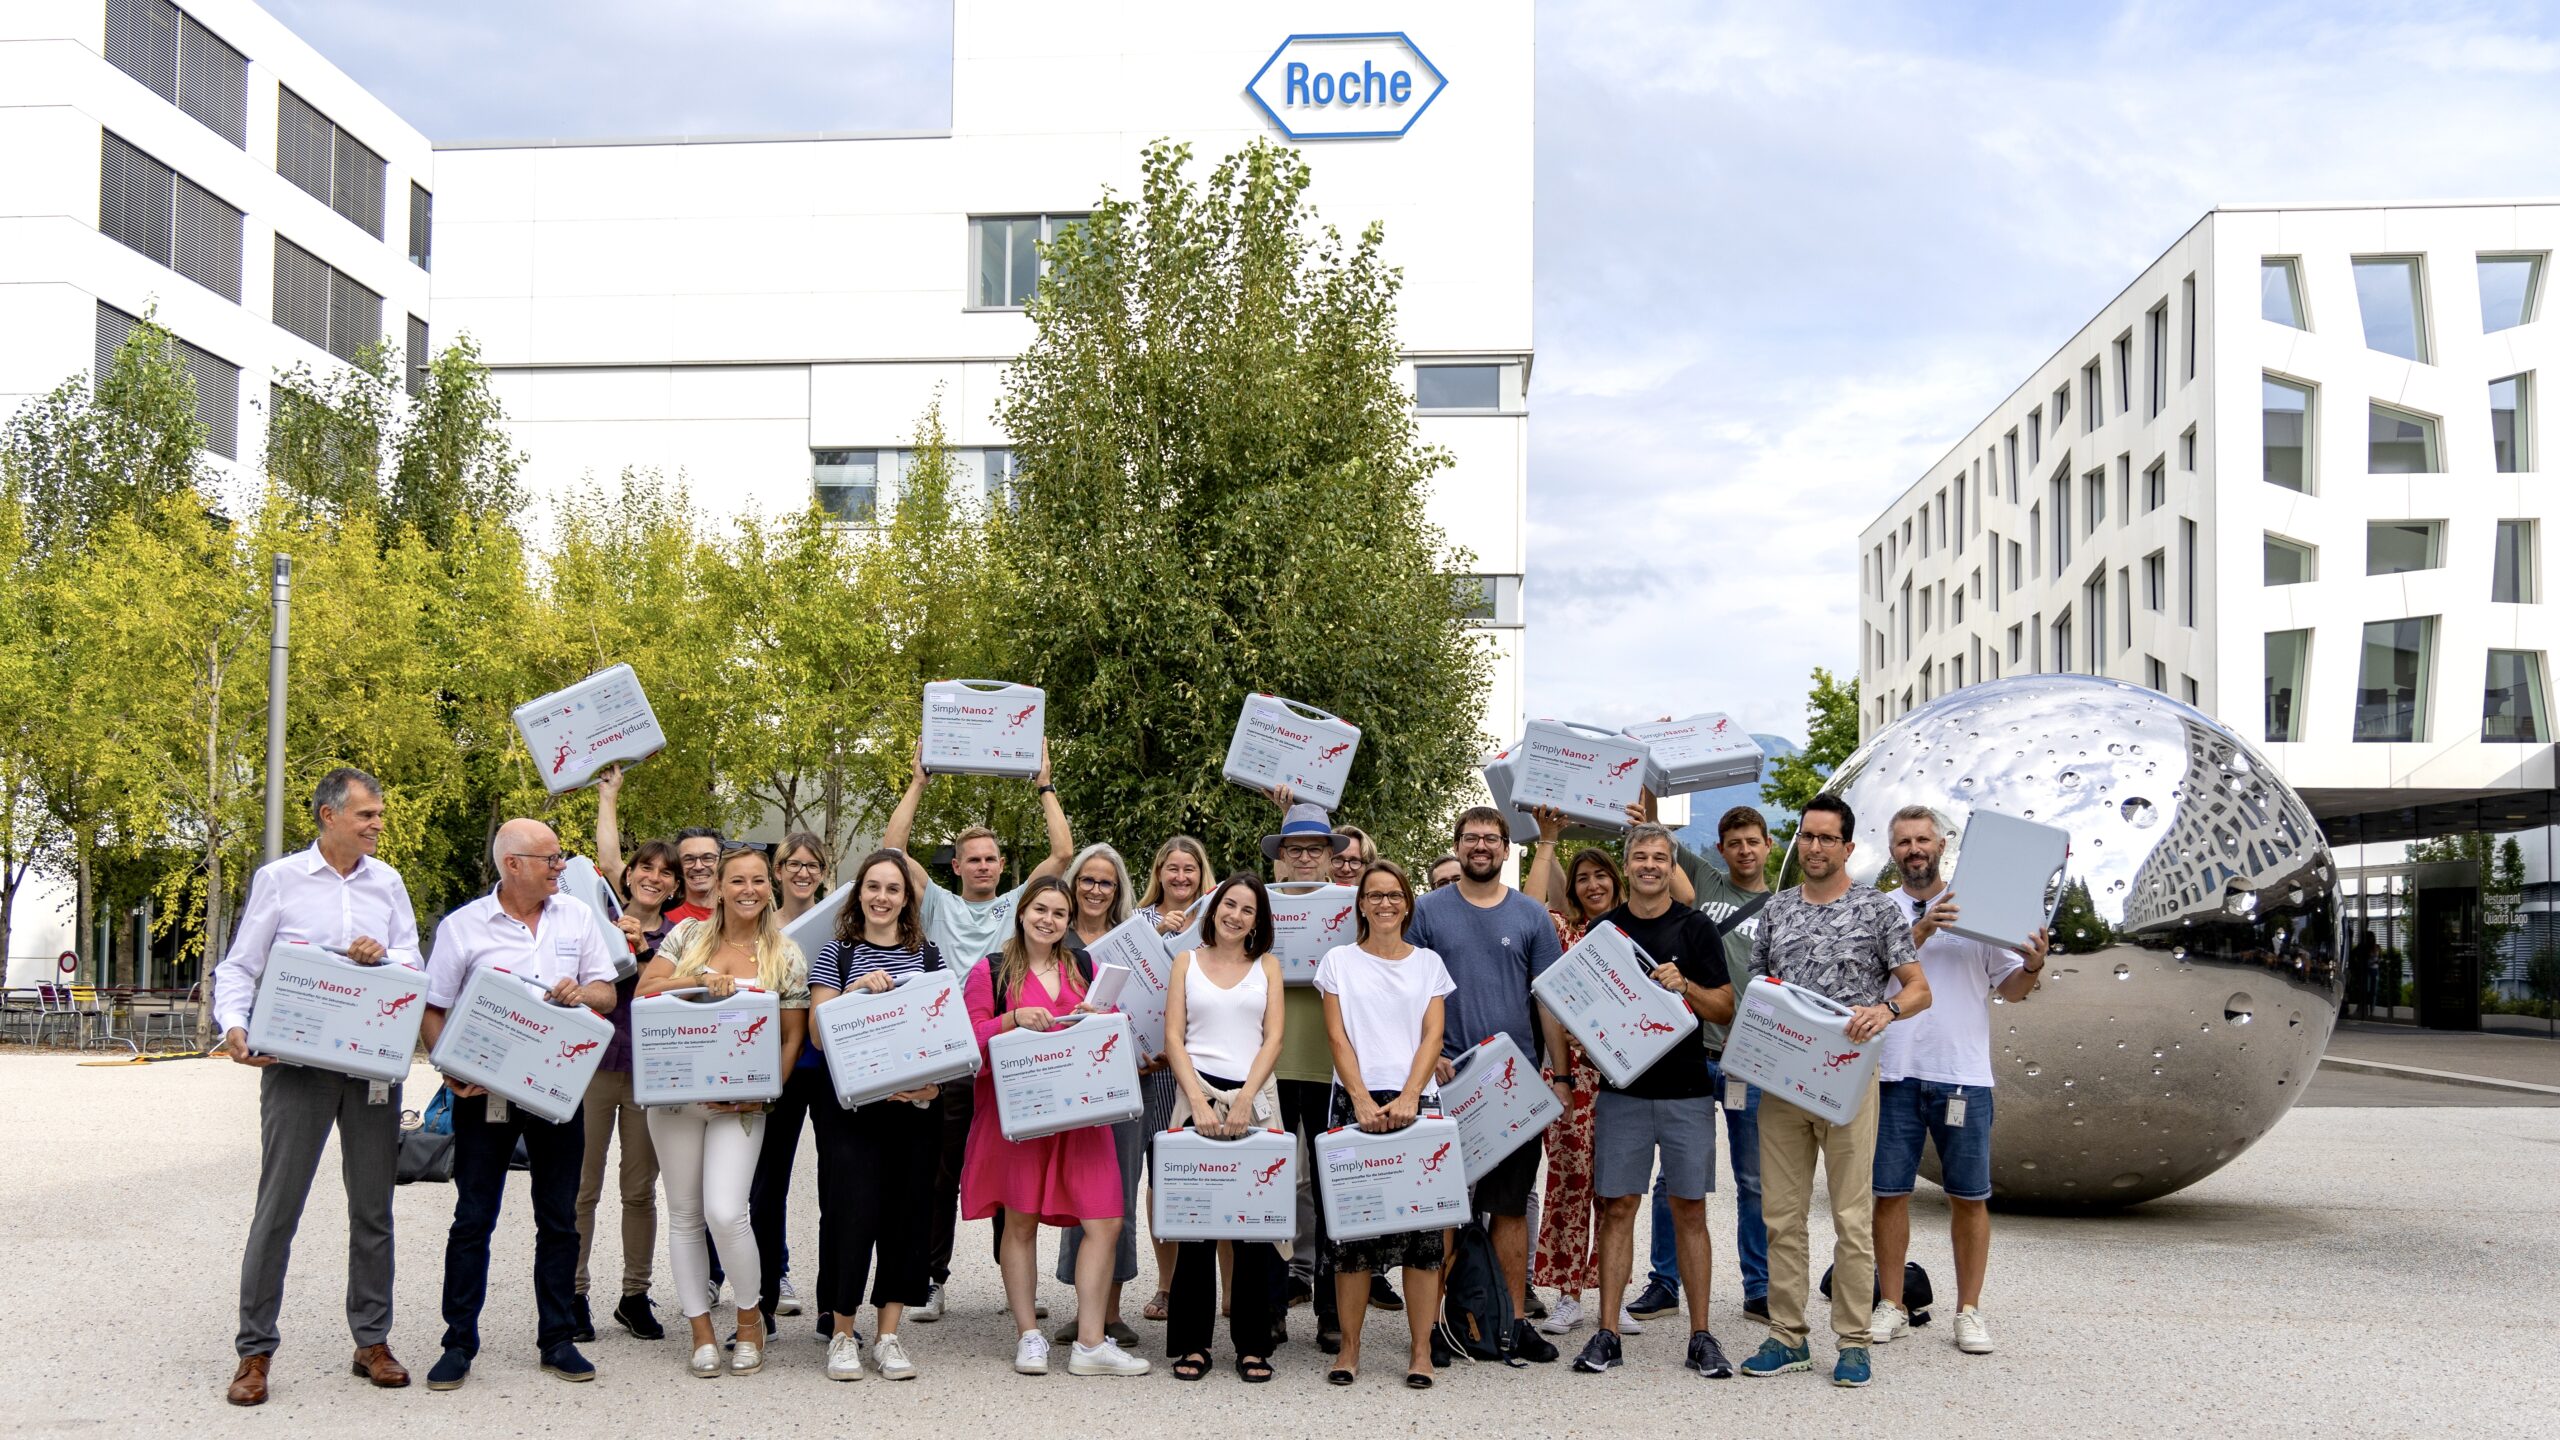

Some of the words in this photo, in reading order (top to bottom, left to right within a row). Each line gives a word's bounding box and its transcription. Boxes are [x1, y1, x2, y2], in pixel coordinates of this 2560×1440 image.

[1286, 58, 1412, 106] Roche
[2483, 892, 2521, 905] Restaurant
[2483, 911, 2510, 926] Quadra
[2510, 911, 2529, 927] Lago
